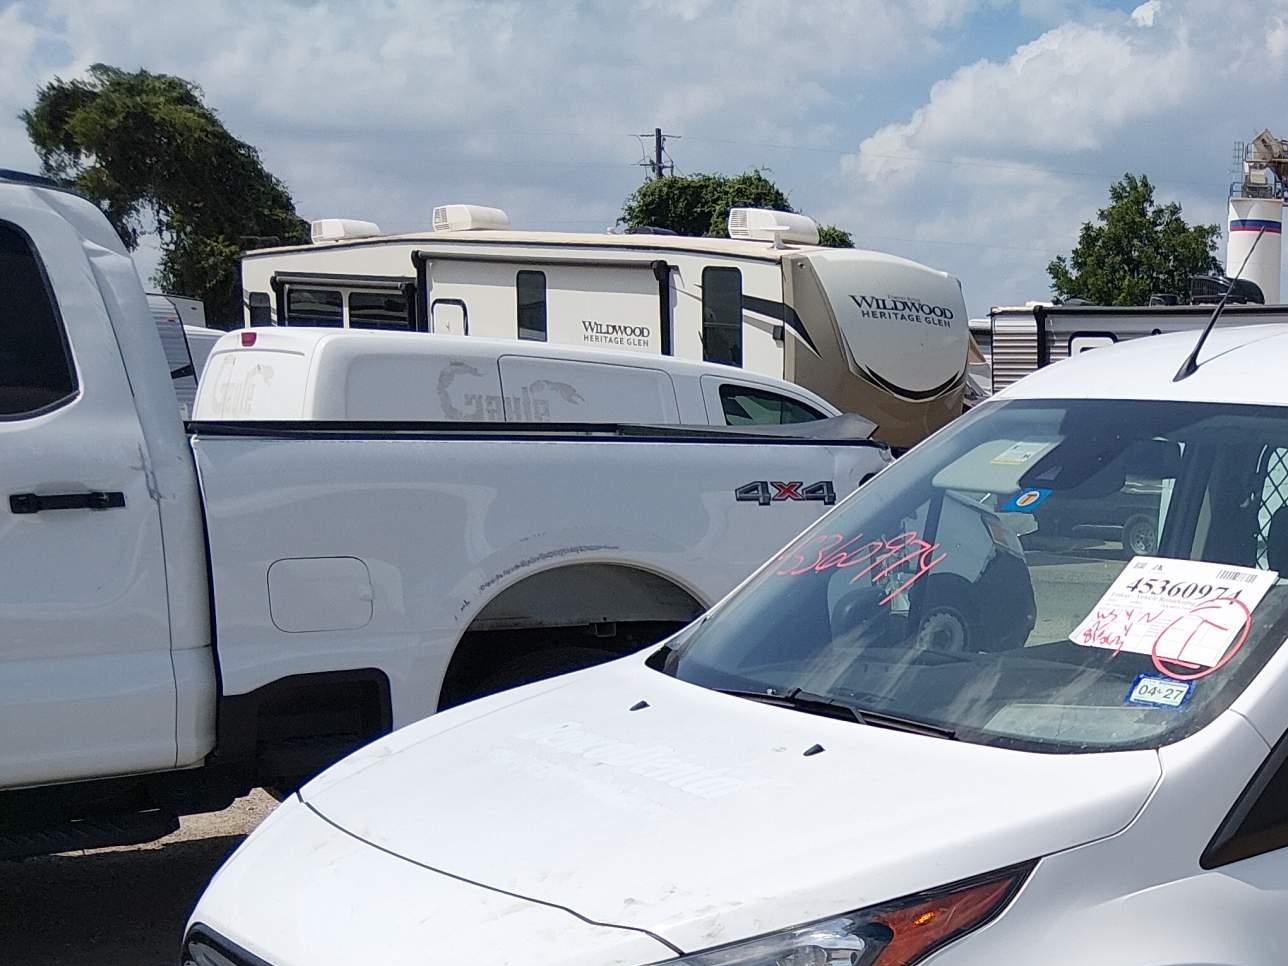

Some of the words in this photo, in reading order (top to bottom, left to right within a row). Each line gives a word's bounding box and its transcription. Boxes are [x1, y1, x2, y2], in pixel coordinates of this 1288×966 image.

[848, 294, 954, 320] WILDWOOD
[861, 309, 921, 323] HERITAGE
[925, 316, 952, 328] GLEN
[582, 320, 650, 338] WILDWOOD
[583, 334, 624, 345] HERITAGE
[626, 338, 649, 347] GLEN
[1126, 576, 1243, 605] 45360974
[1138, 685, 1157, 696] 04
[1163, 689, 1185, 700] 27
